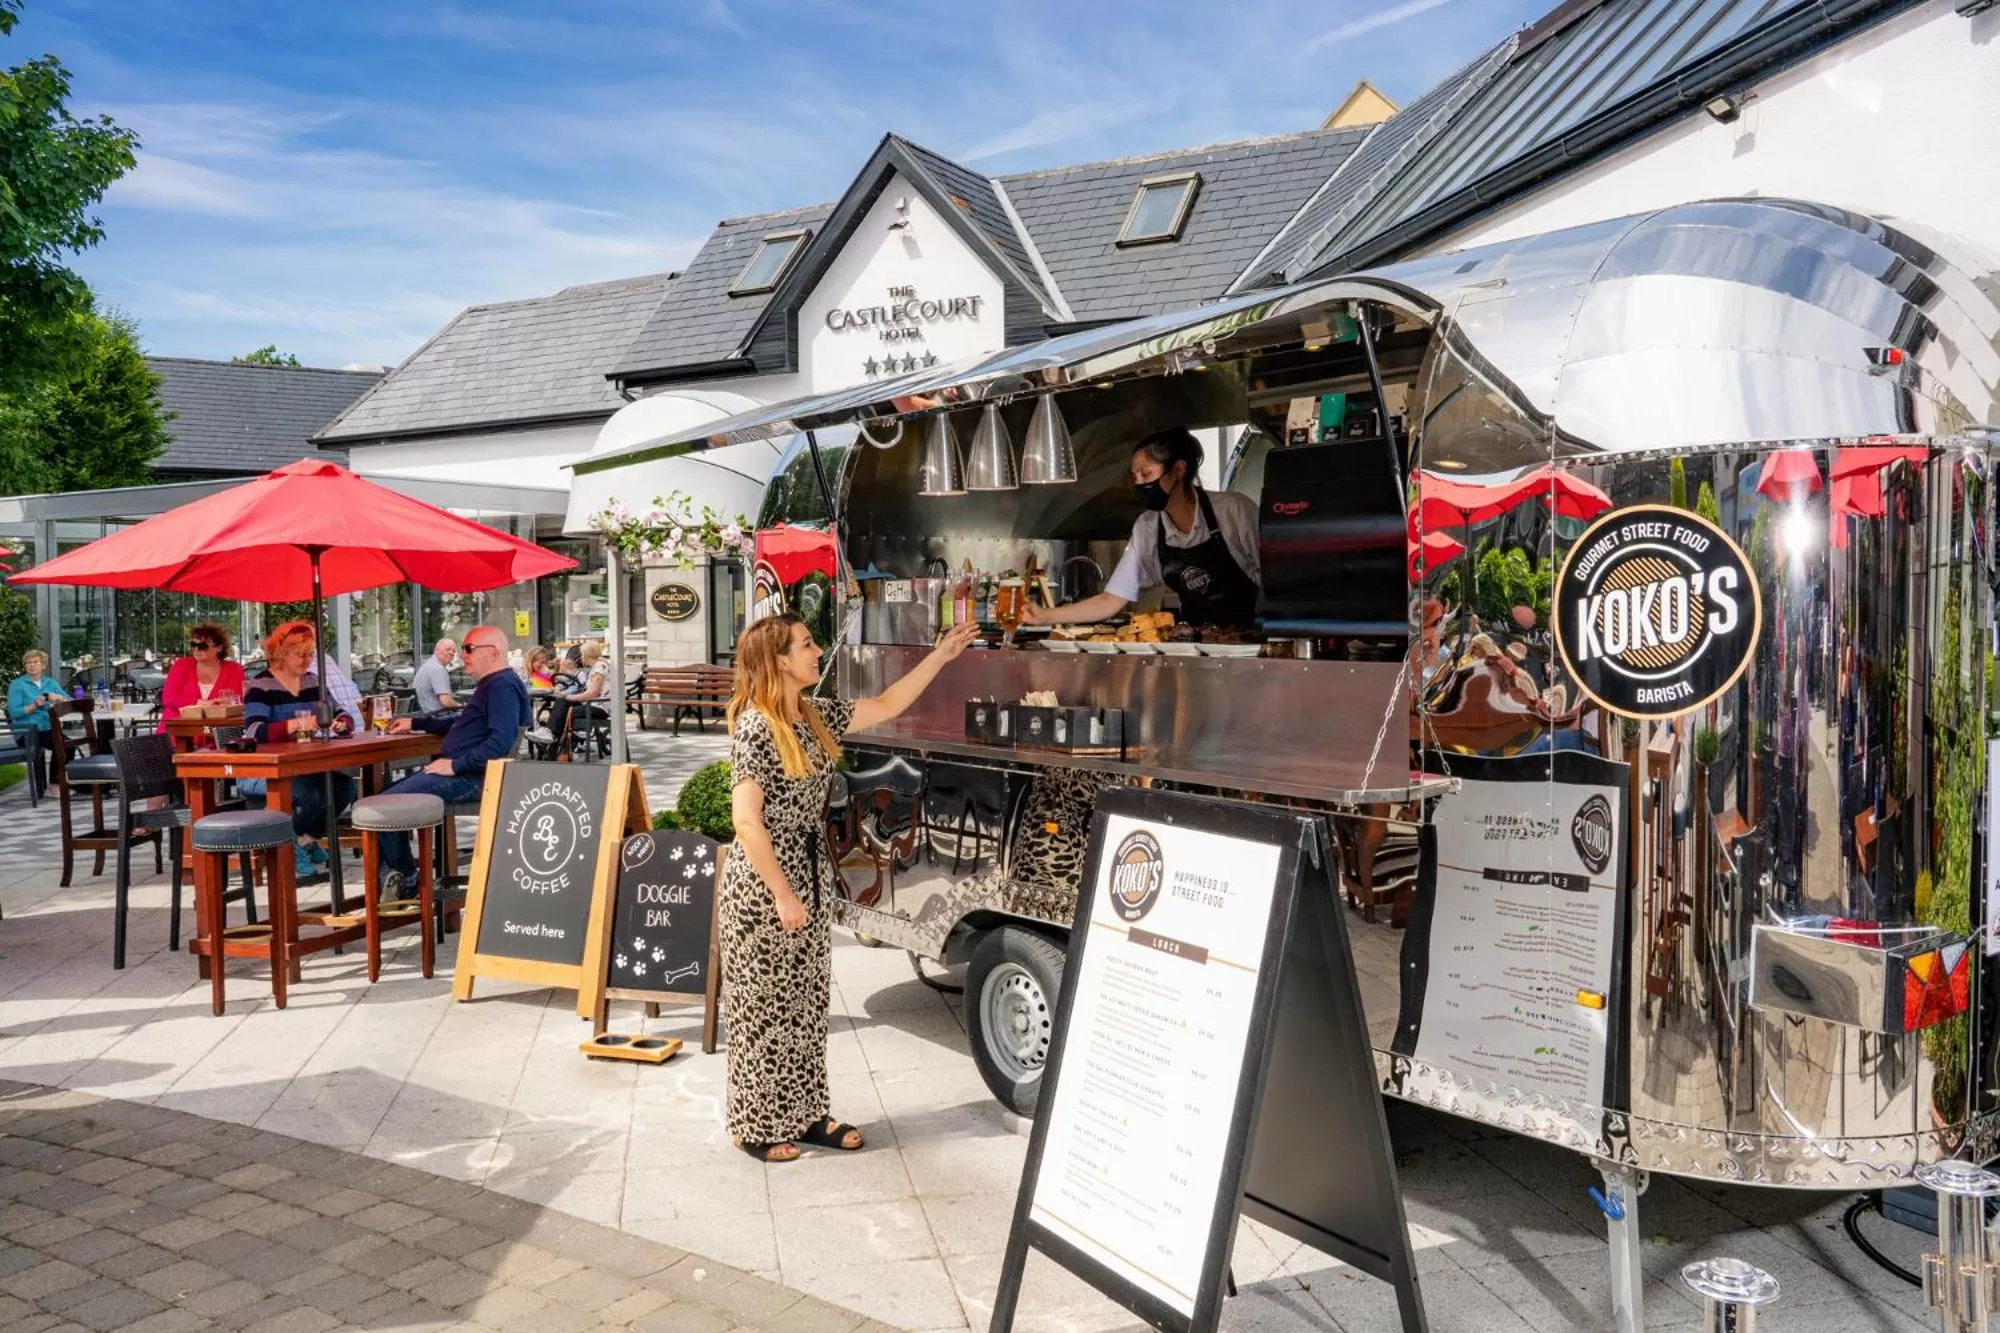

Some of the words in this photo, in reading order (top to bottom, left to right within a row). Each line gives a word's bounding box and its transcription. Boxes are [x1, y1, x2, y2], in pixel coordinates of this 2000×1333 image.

[887, 285, 914, 298] THE
[826, 296, 981, 330] CASTLECOURT
[880, 328, 921, 341] HOTEL
[1574, 530, 1620, 581] GOURMET
[1623, 522, 1672, 541] STREET
[1673, 526, 1711, 553] FOOD
[1578, 566, 1739, 661] KOKO'S
[1637, 681, 1694, 704] BARISTA
[506, 782, 592, 838] HANDCRAFTED
[512, 867, 571, 895] COFFEE
[1112, 859, 1162, 895] KOKO'S
[1174, 870, 1218, 890] HAPPINESS
[637, 884, 691, 904] DOGGIE
[1171, 886, 1201, 903] STREET
[1202, 894, 1224, 909] FOOD
[504, 920, 539, 937] Served
[541, 923, 565, 939] here
[644, 909, 671, 927] BAR
